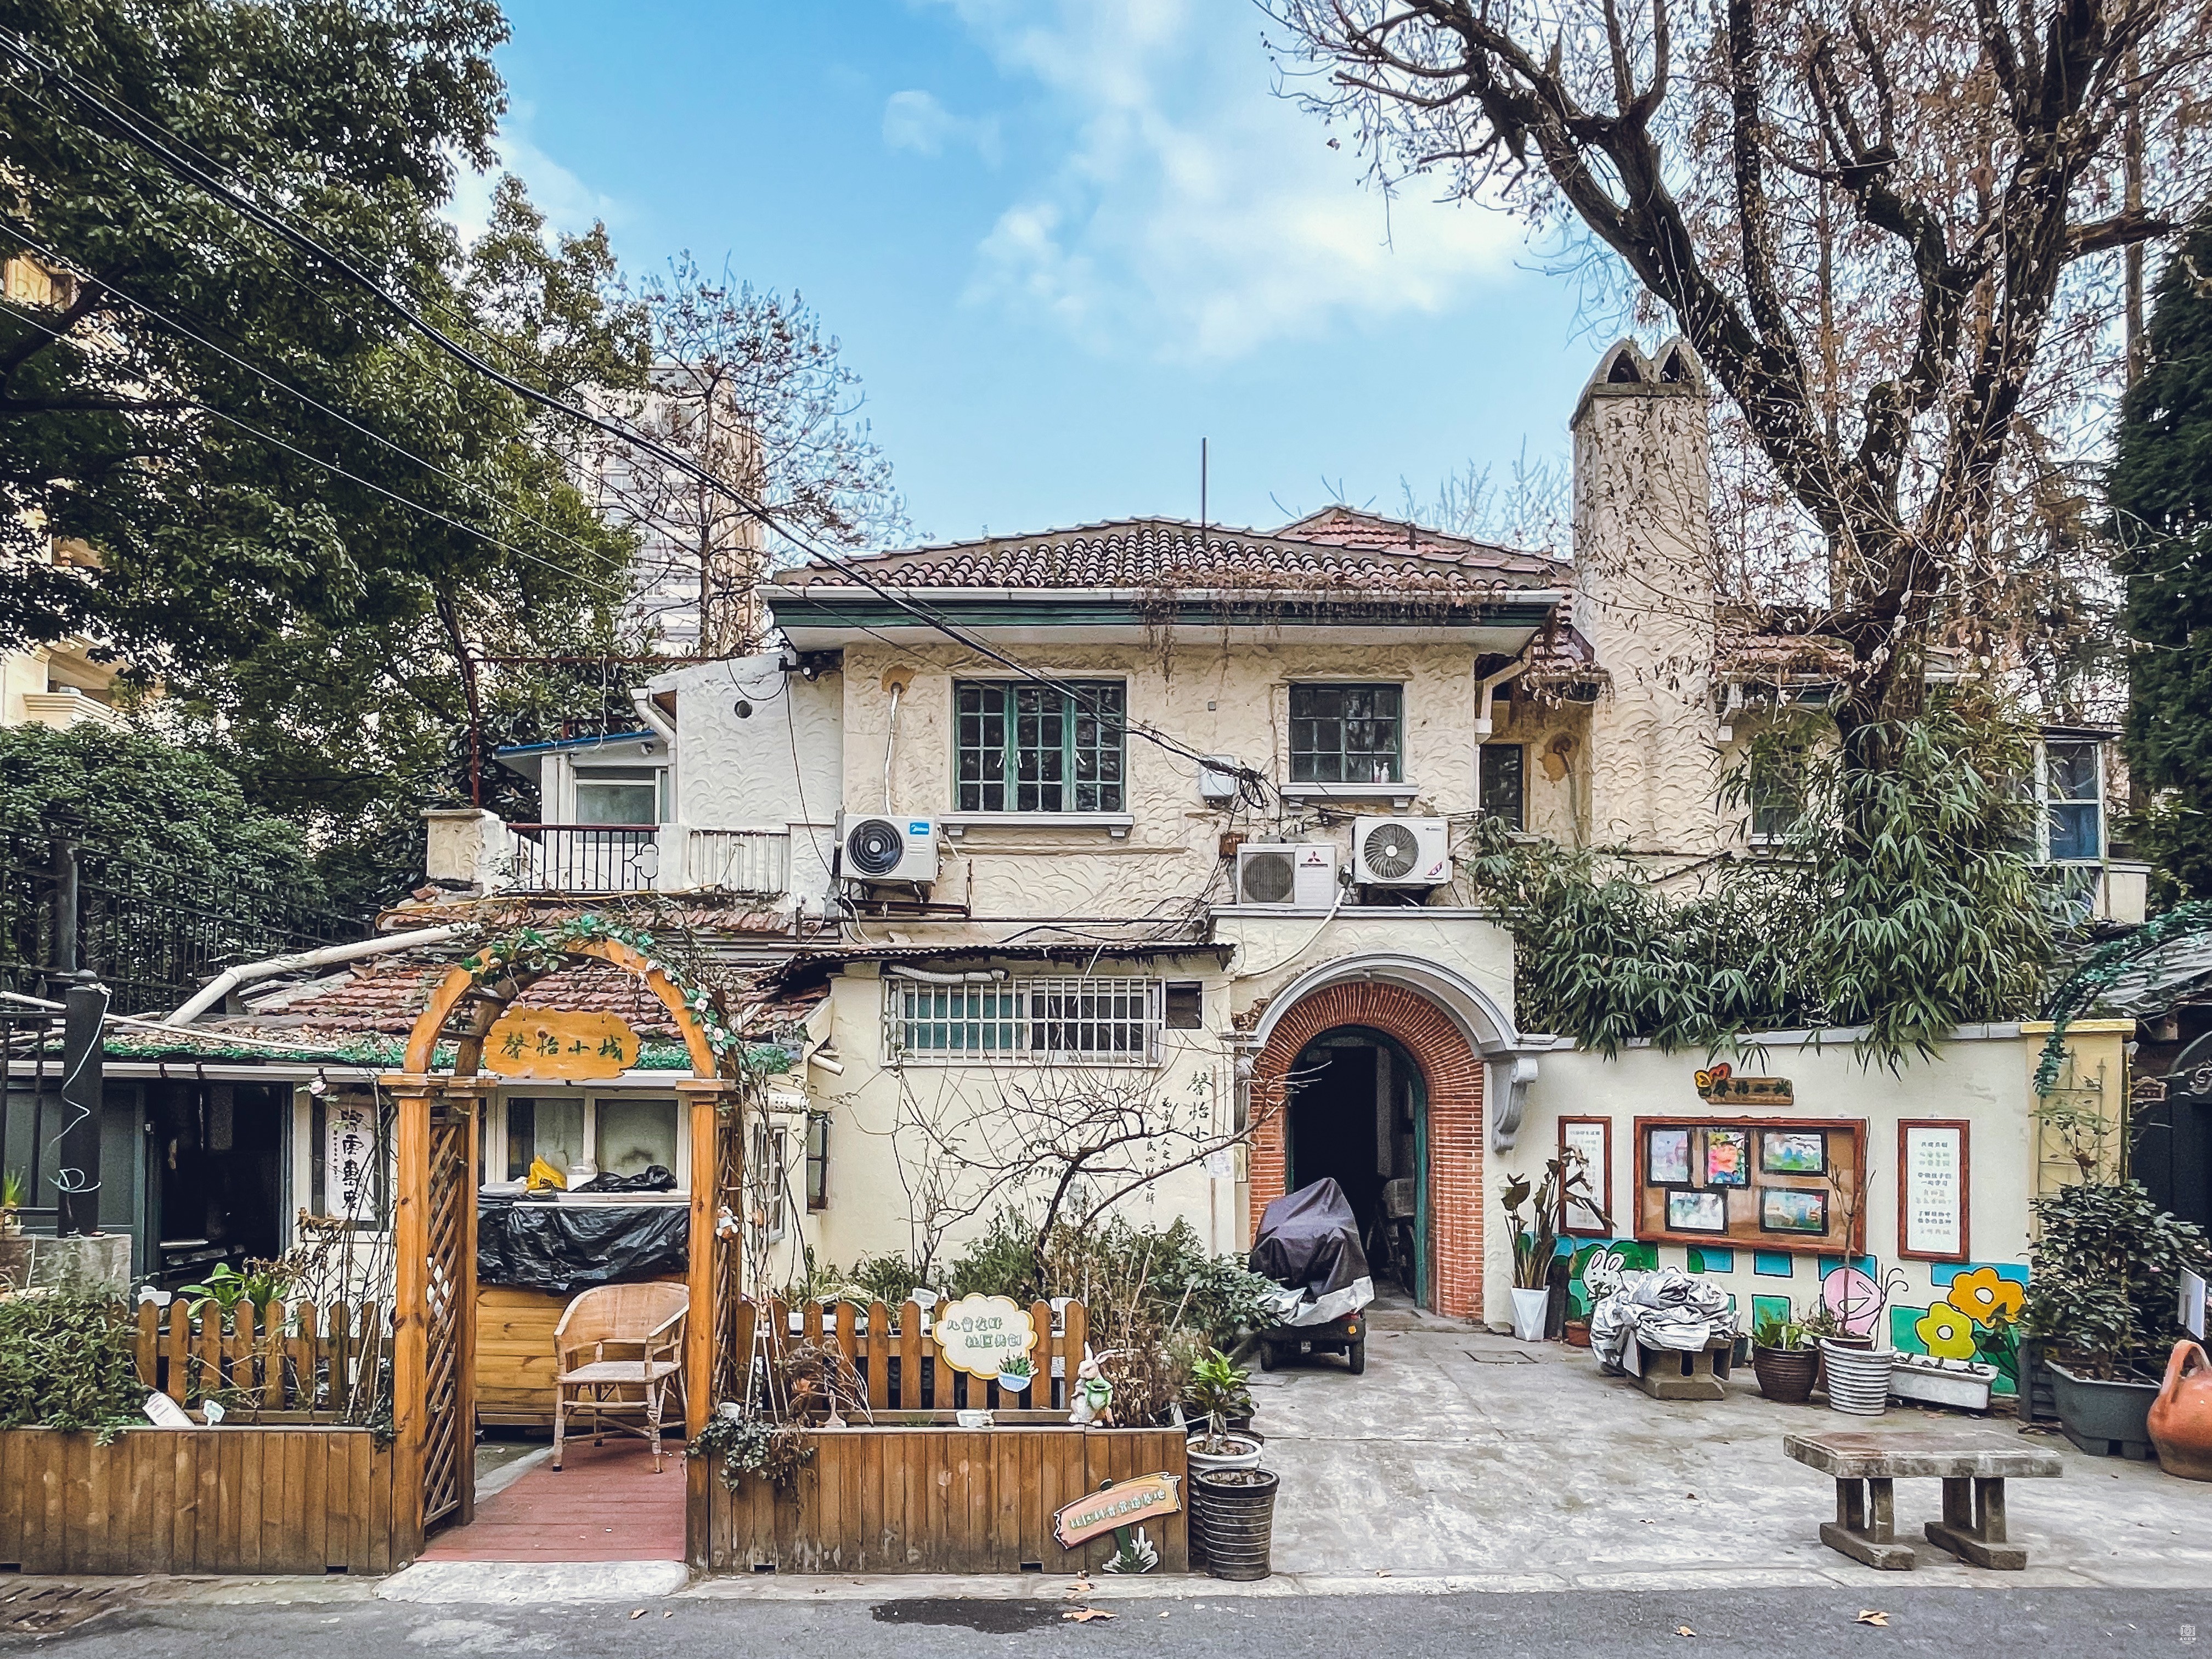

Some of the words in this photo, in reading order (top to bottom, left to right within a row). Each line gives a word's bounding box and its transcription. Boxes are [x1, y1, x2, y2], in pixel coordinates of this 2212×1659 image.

[947, 1316, 1002, 1332] 儿童友好
[965, 1333, 1022, 1348] 社区共创
